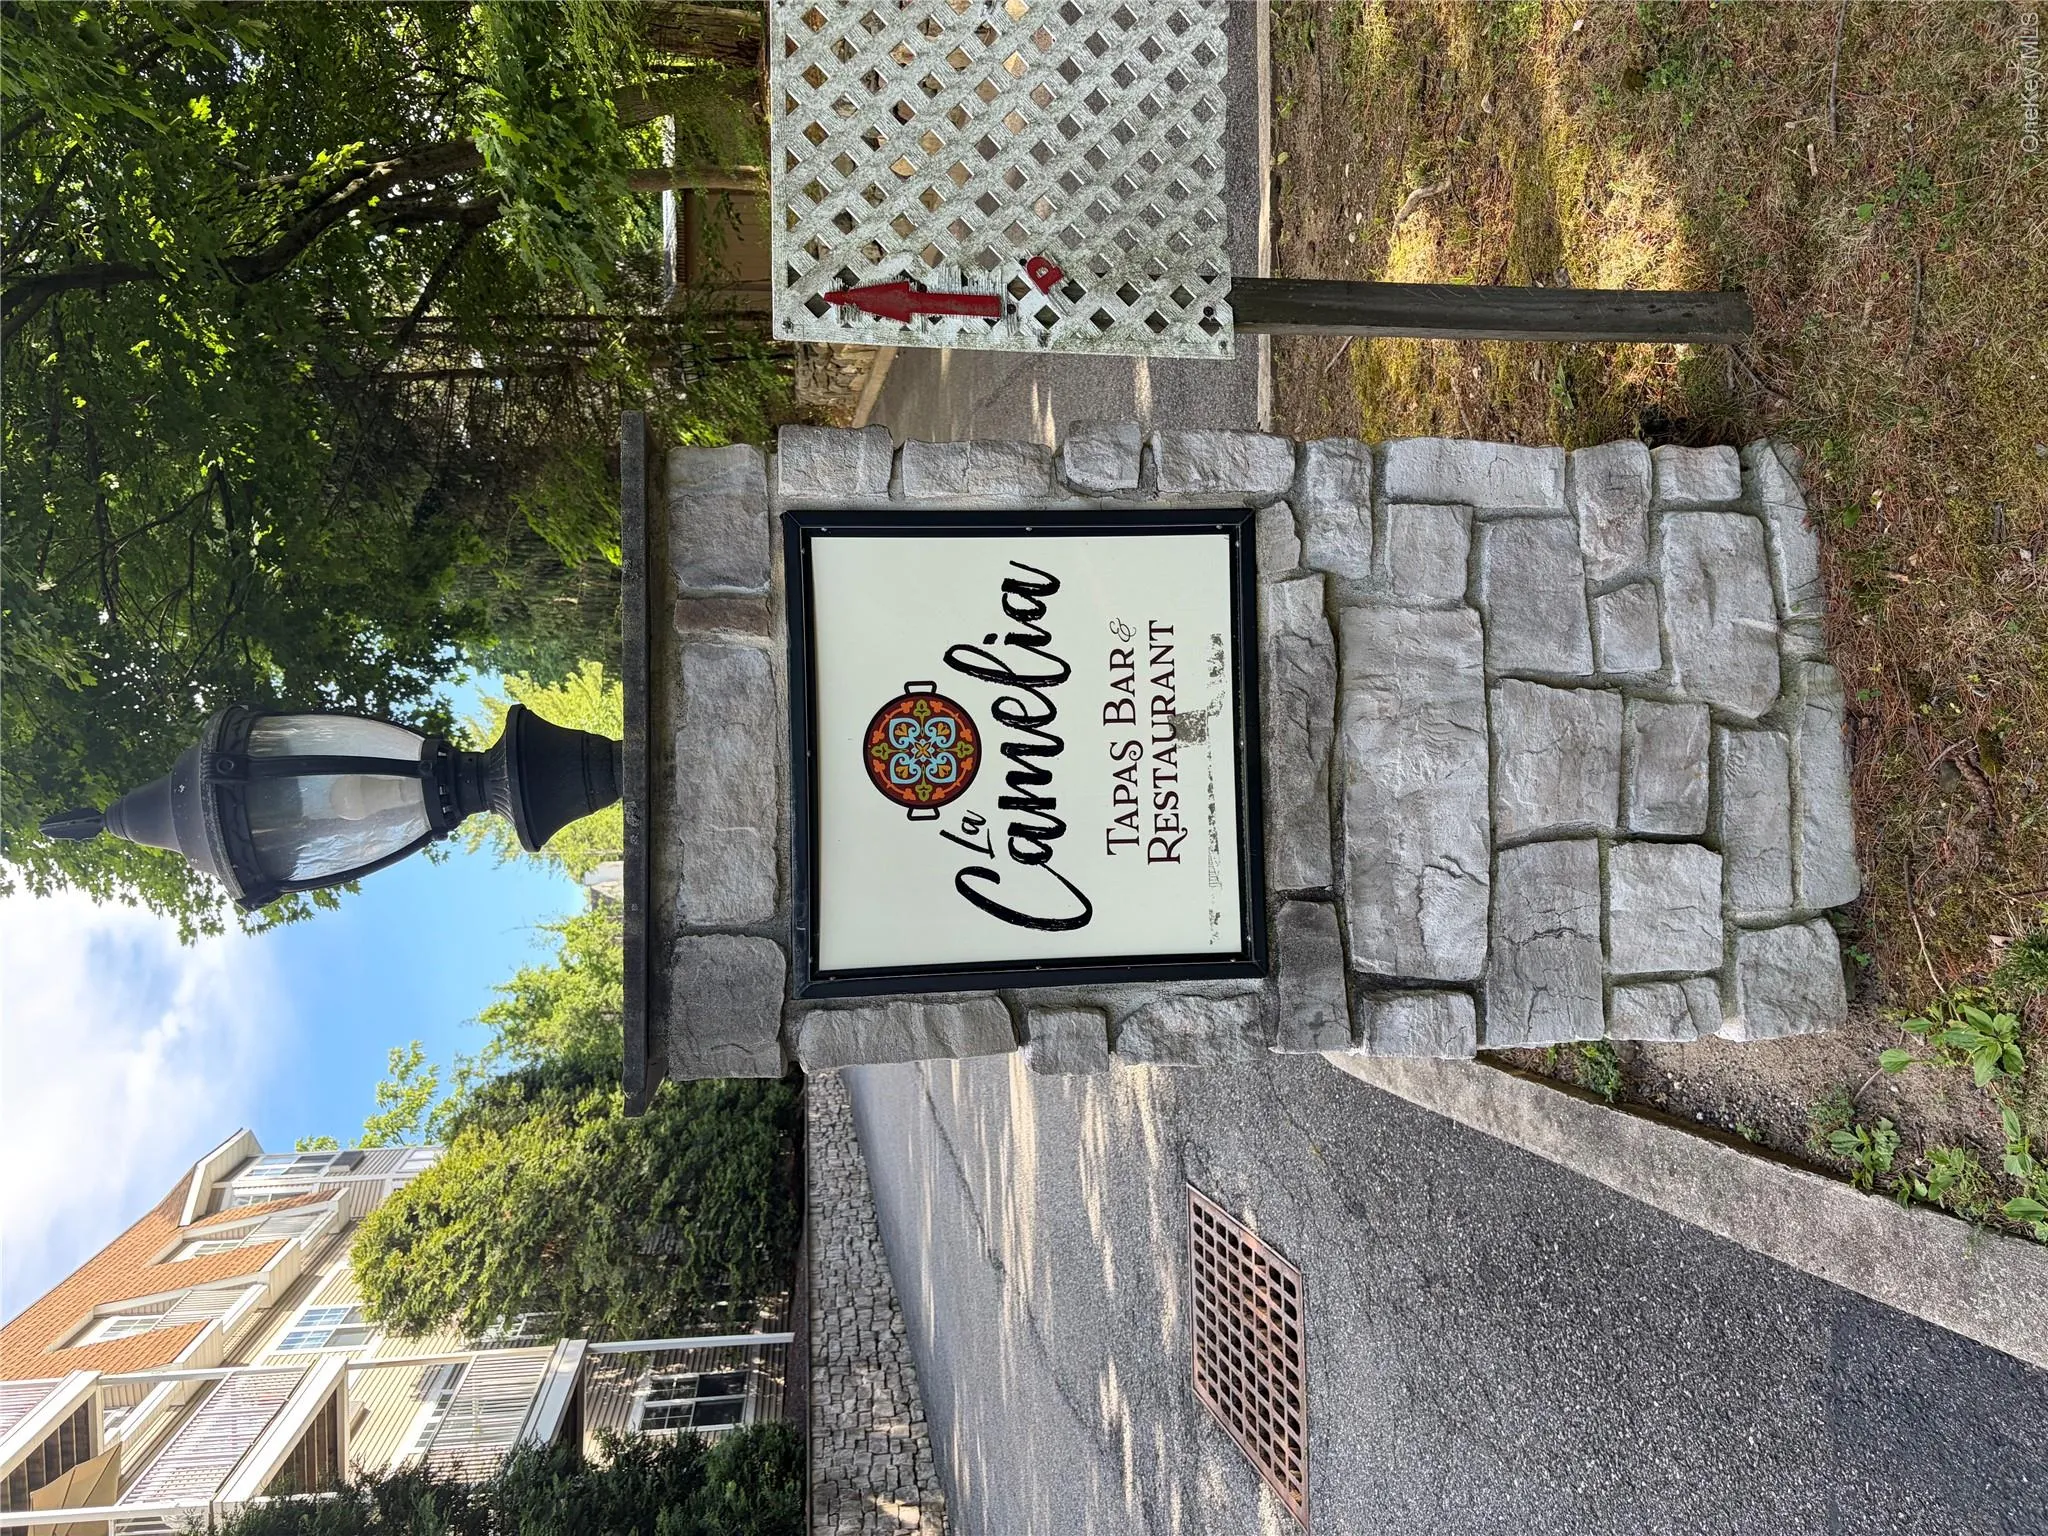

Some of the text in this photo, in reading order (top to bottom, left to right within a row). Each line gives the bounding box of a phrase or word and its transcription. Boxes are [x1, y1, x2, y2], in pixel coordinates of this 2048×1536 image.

[939, 810, 995, 859] La
[942, 560, 1093, 932] Camelia
[1102, 618, 1144, 856] TAPAS BAR &
[1147, 620, 1188, 866] RESTAURANT
